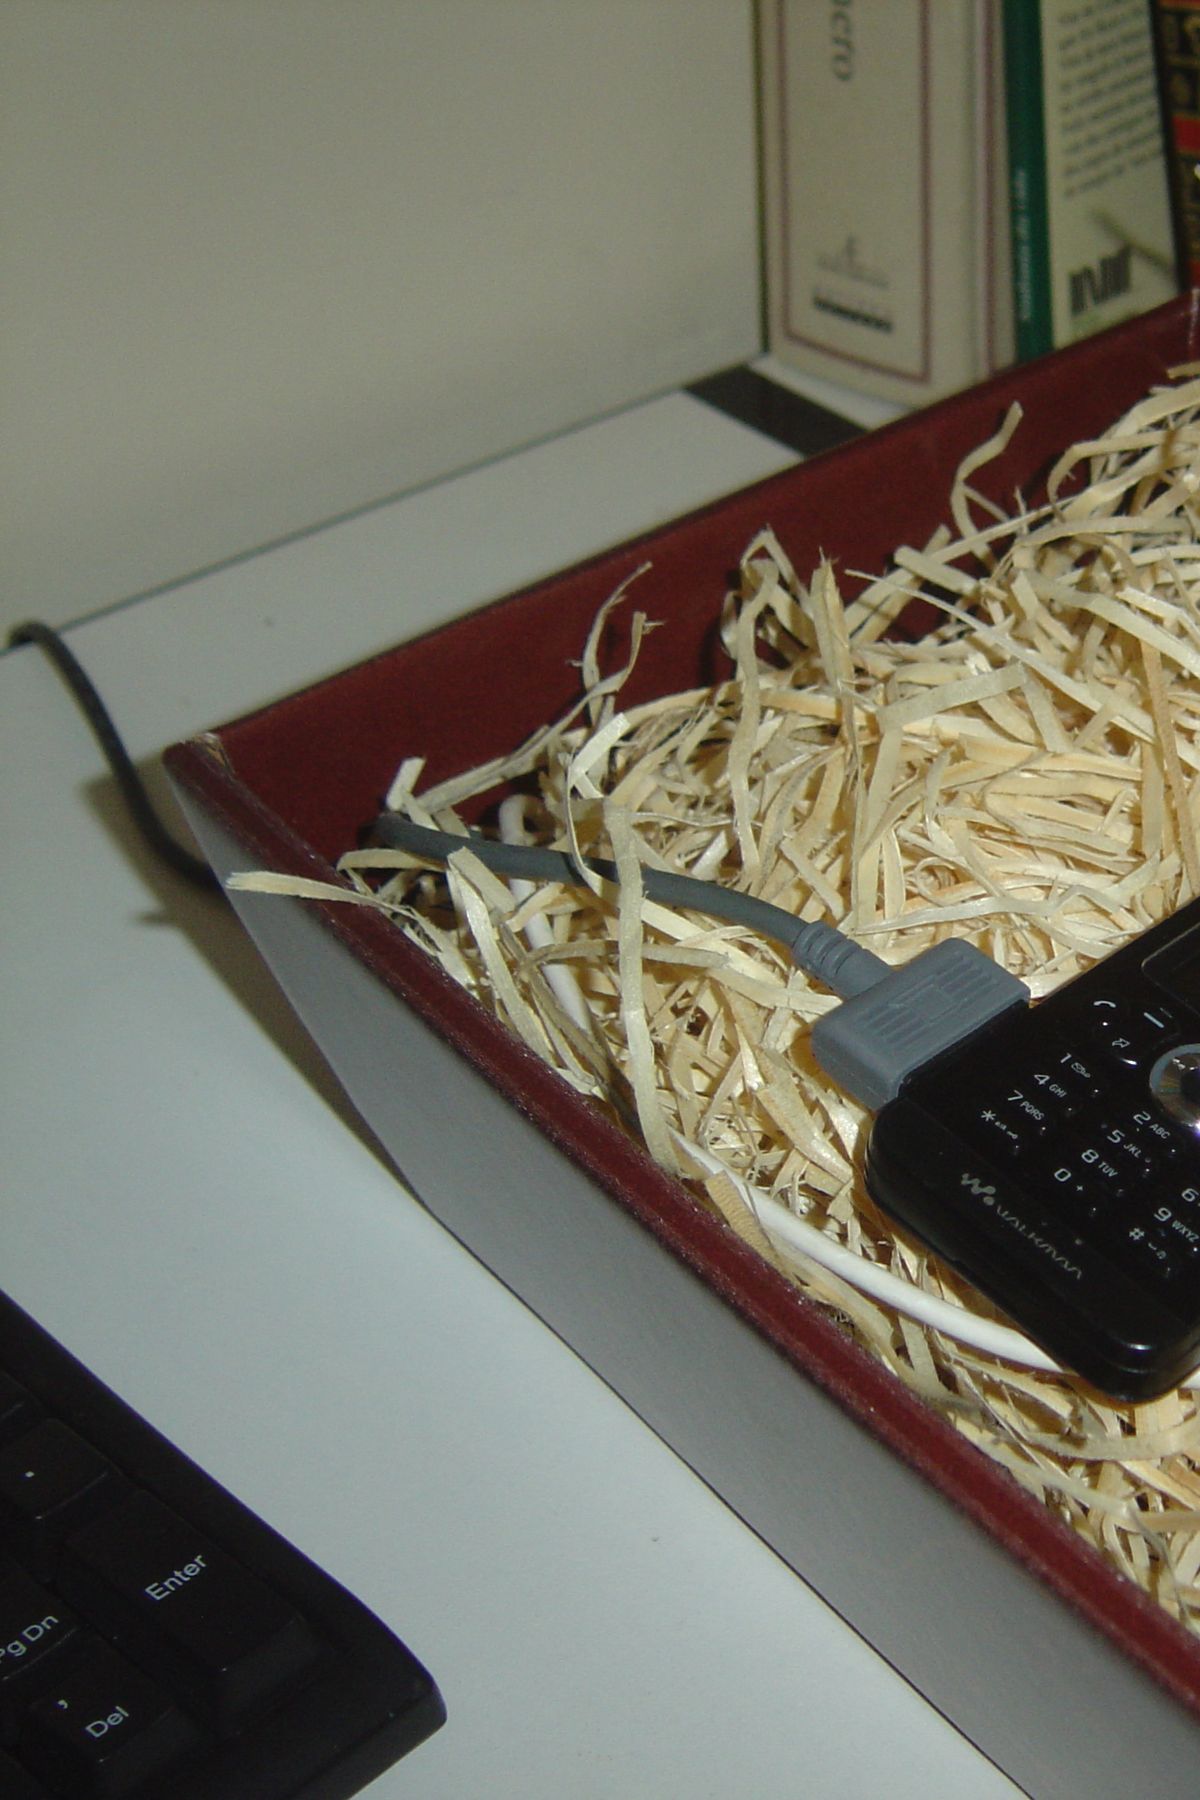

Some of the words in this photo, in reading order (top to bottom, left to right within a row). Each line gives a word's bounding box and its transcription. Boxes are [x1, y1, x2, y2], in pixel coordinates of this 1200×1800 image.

[1034, 1073, 1050, 1085] 4
[1049, 1083, 1067, 1097] GHI
[1007, 1090, 1023, 1101] 7
[1020, 1100, 1045, 1121] PQRS
[1133, 1111, 1151, 1125] 2
[1148, 1120, 1171, 1140] ABC
[1107, 1130, 1125, 1143] 5
[1123, 1142, 1141, 1158] JKL
[1081, 1149, 1099, 1163] 8
[1098, 1161, 1118, 1177] TUV
[1181, 1188, 1199, 1202] 6
[1154, 1207, 1172, 1222] 9
[1171, 1220, 1200, 1243] WXYZ
[145, 1553, 209, 1601] Enter
[22, 1614, 59, 1642] Dn
[85, 1706, 131, 1739] Del
